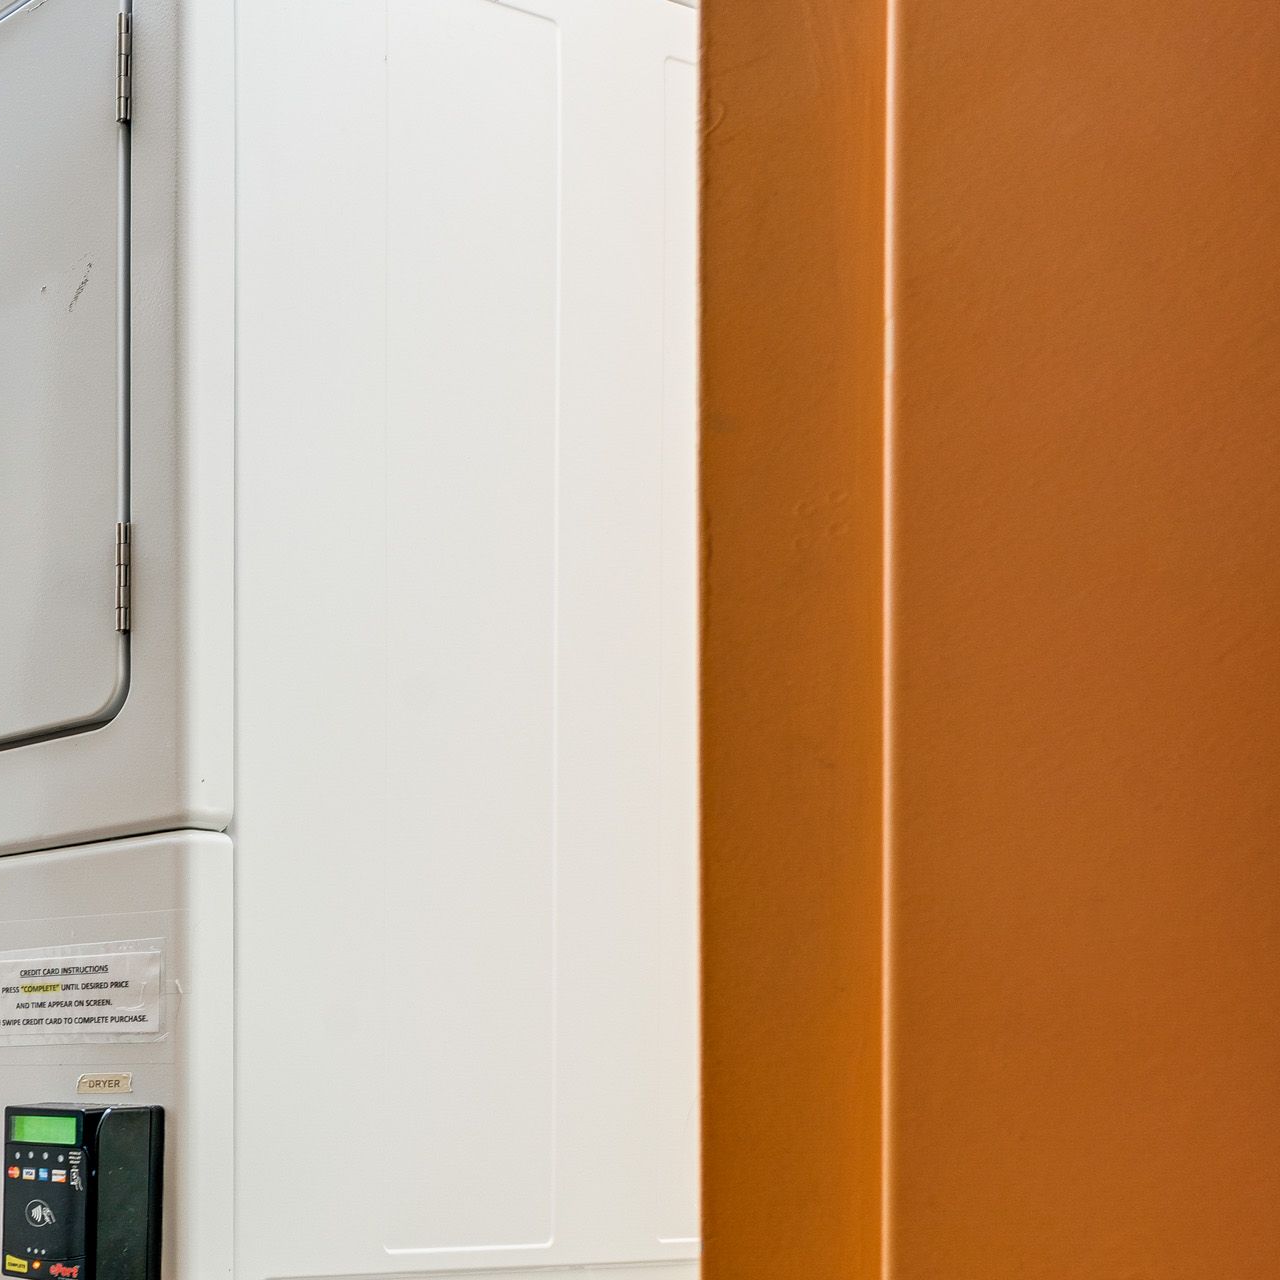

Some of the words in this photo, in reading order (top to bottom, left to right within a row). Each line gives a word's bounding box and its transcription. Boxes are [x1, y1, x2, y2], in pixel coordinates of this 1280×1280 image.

[20, 968, 41, 977] CREDIT
[42, 967, 60, 976] CARD
[61, 964, 109, 975] INSTRUCTIONS
[1, 986, 20, 994] PRESS
[61, 983, 80, 991] UNTIL
[81, 981, 109, 990] DESIRED
[110, 980, 129, 989] PRICE
[16, 1001, 30, 1009] AND
[31, 1001, 47, 1009] TIME
[48, 1000, 73, 1008] APPEAR
[85, 998, 113, 1007] SCREEN.
[2, 1018, 21, 1026] SWIPE
[22, 1018, 44, 1026] CREDIT
[45, 1017, 62, 1025] CARD
[64, 1017, 73, 1025] TO
[74, 1016, 109, 1024] COMPLETE
[110, 1014, 149, 1023] PURCHASE.
[88, 1079, 121, 1089] DRYER
